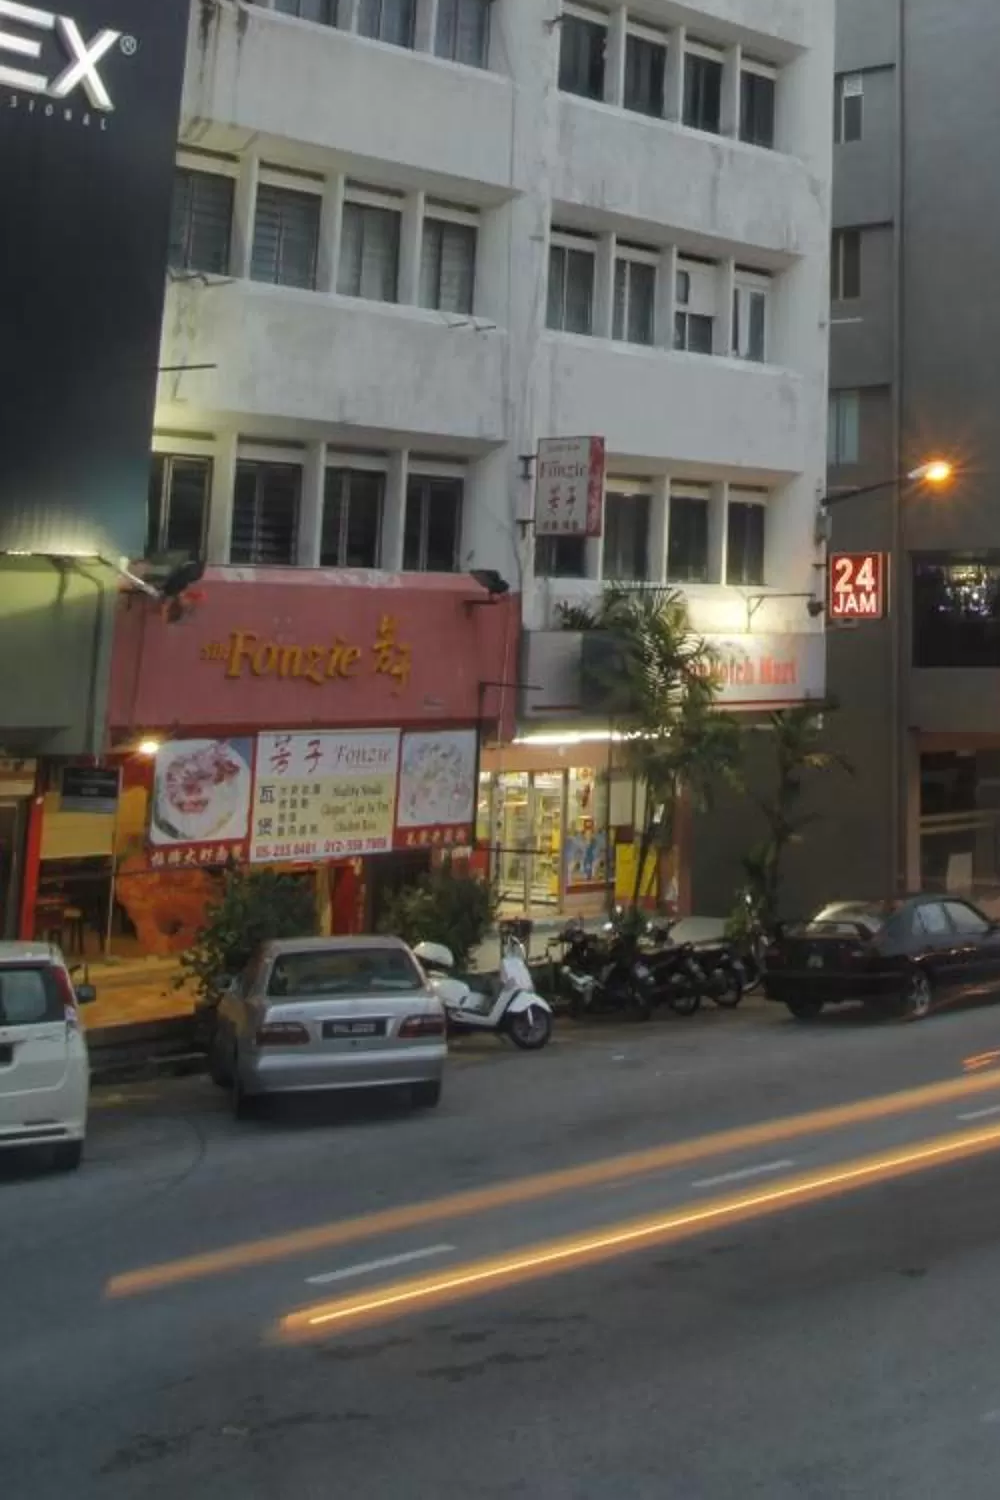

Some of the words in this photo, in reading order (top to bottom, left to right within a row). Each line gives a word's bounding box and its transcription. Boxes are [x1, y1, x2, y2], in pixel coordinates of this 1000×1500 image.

[834, 557, 875, 593] 24
[833, 592, 876, 613] JAM
[224, 628, 361, 686] Fonzie
